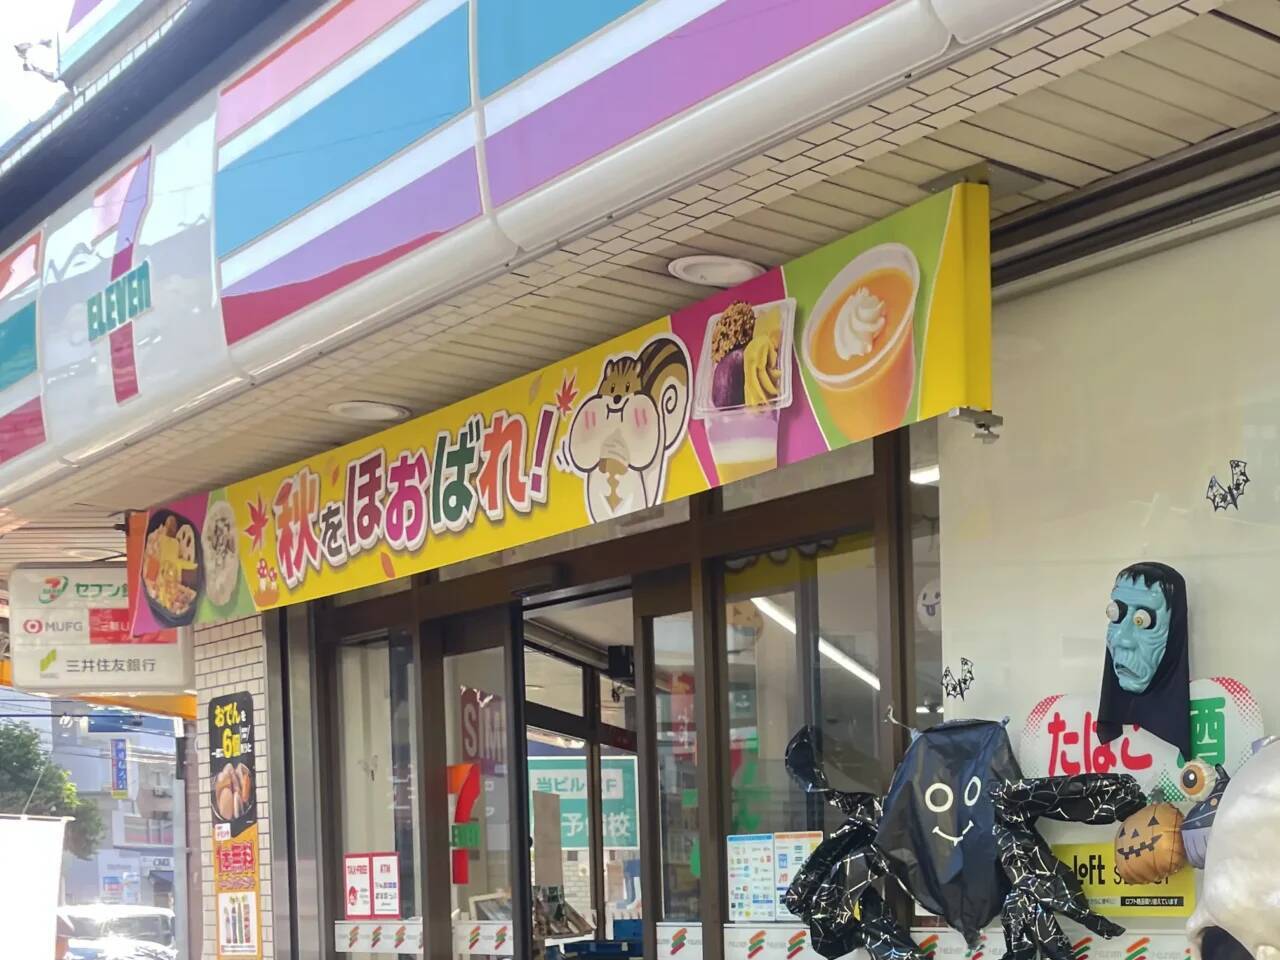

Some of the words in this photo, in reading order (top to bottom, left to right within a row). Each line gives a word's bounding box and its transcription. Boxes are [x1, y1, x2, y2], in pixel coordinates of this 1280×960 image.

[45, 620, 83, 632] MUFG
[65, 658, 157, 673] 三井住友銀行
[536, 776, 617, 793] 当ビルF
